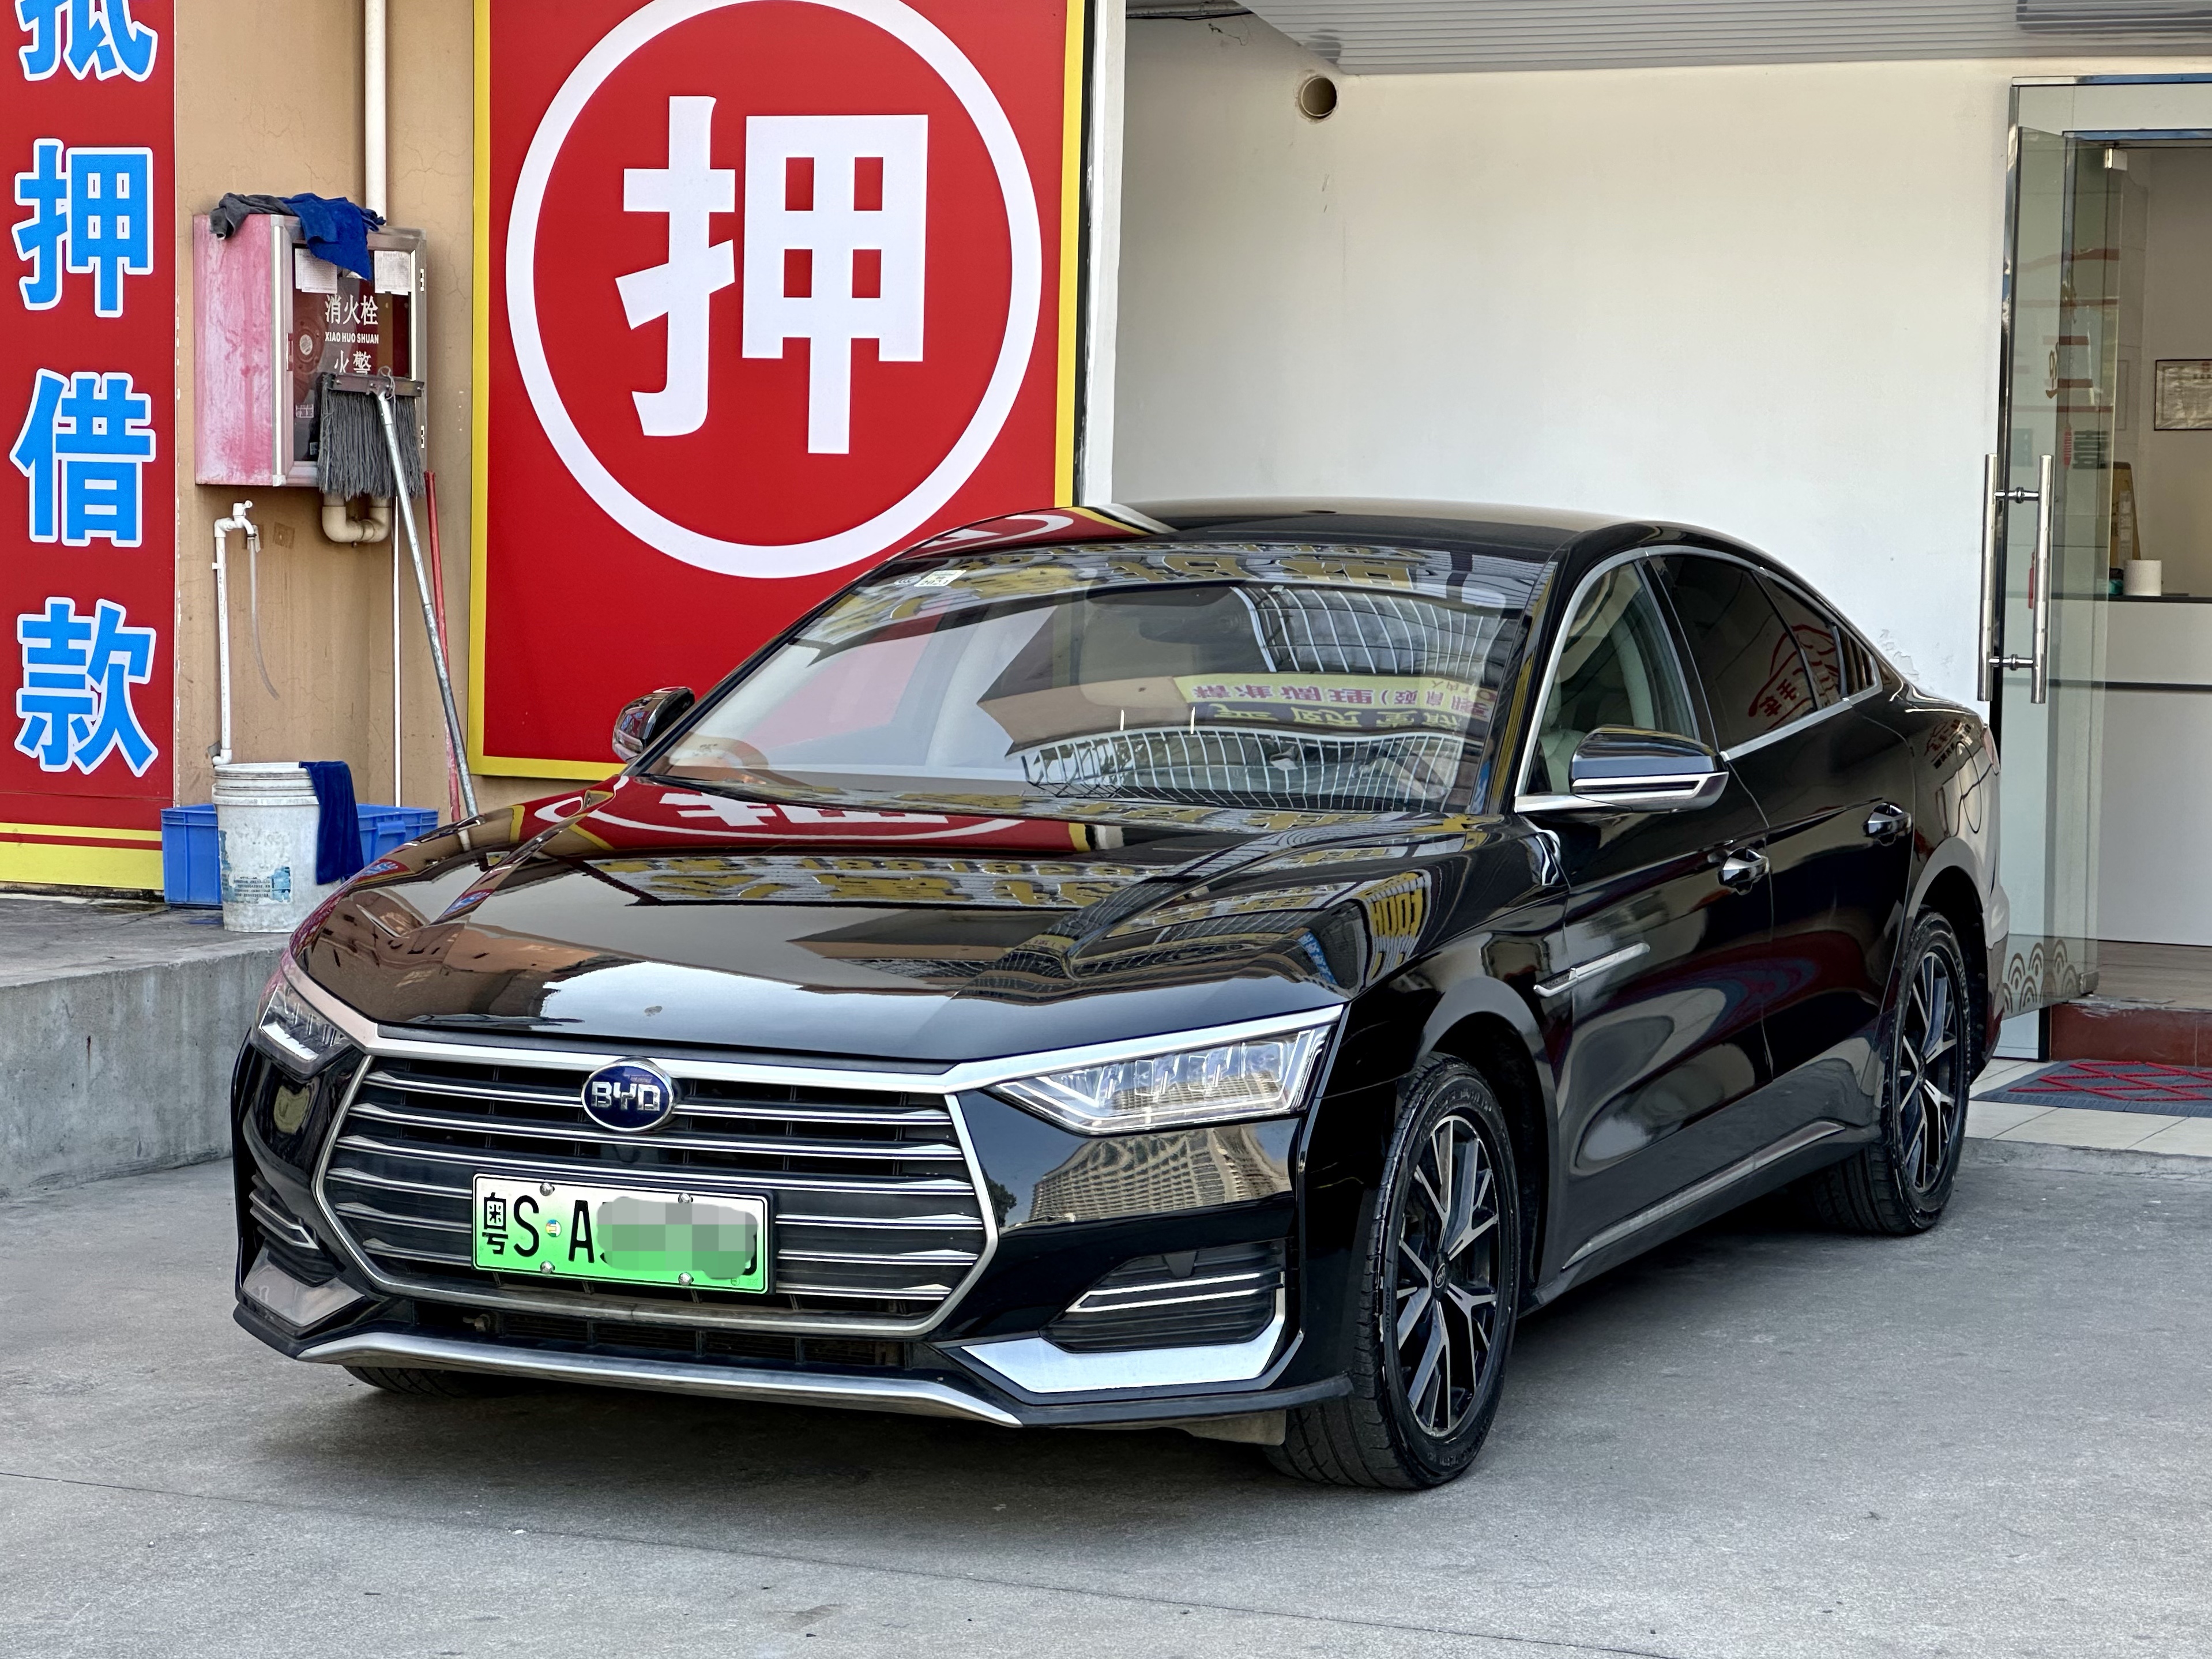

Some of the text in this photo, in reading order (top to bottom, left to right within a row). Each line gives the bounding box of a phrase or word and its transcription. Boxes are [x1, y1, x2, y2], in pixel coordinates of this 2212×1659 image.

[615, 95, 928, 454] 押
[325, 294, 379, 325] 消火栓
[325, 331, 379, 344] XIAO HUO SHUAN
[590, 1081, 661, 1112] BYD
